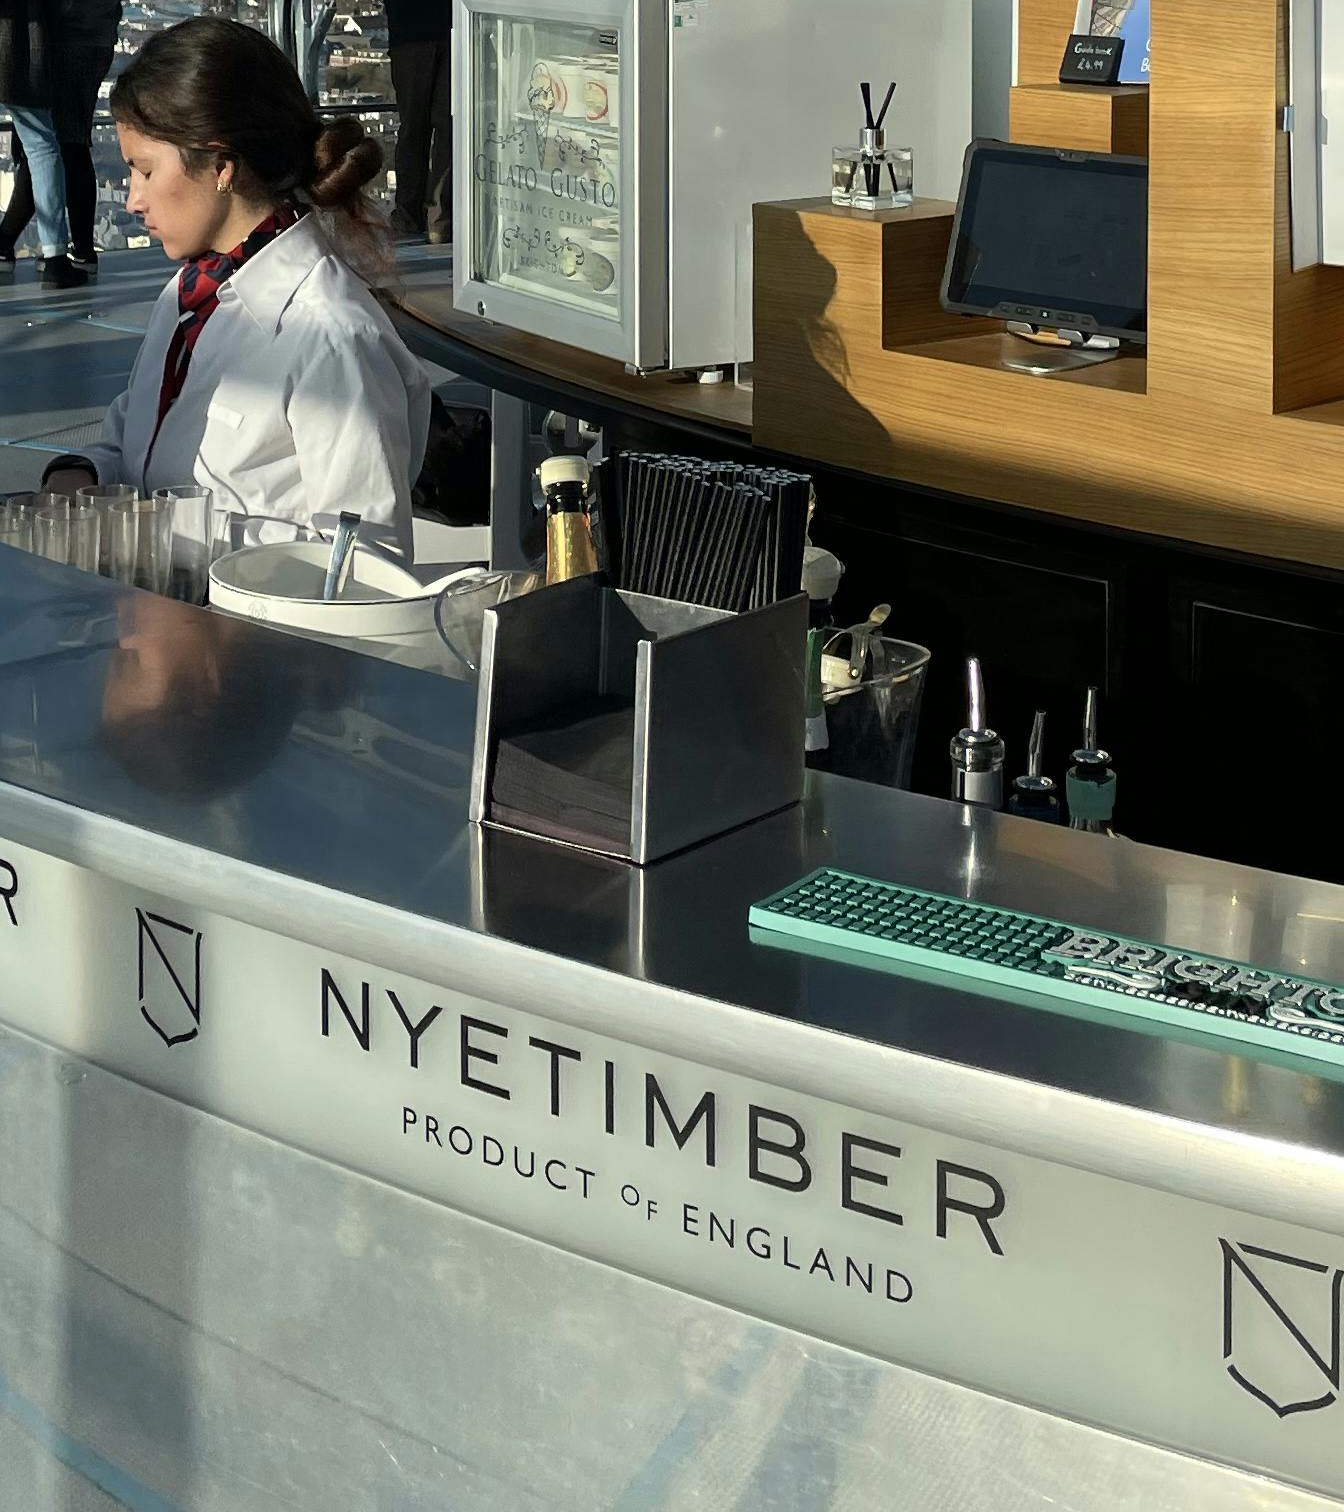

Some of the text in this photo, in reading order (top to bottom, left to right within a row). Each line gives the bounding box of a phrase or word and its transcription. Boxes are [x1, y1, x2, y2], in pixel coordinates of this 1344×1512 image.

[473, 153, 616, 208] GELATO GUSTO
[537, 204, 555, 220] ICE
[558, 208, 594, 228] CREAM
[319, 967, 1010, 1257] NYETIMBER
[400, 1105, 597, 1200] PRODUCT
[681, 1202, 915, 1306] ENGLAND
